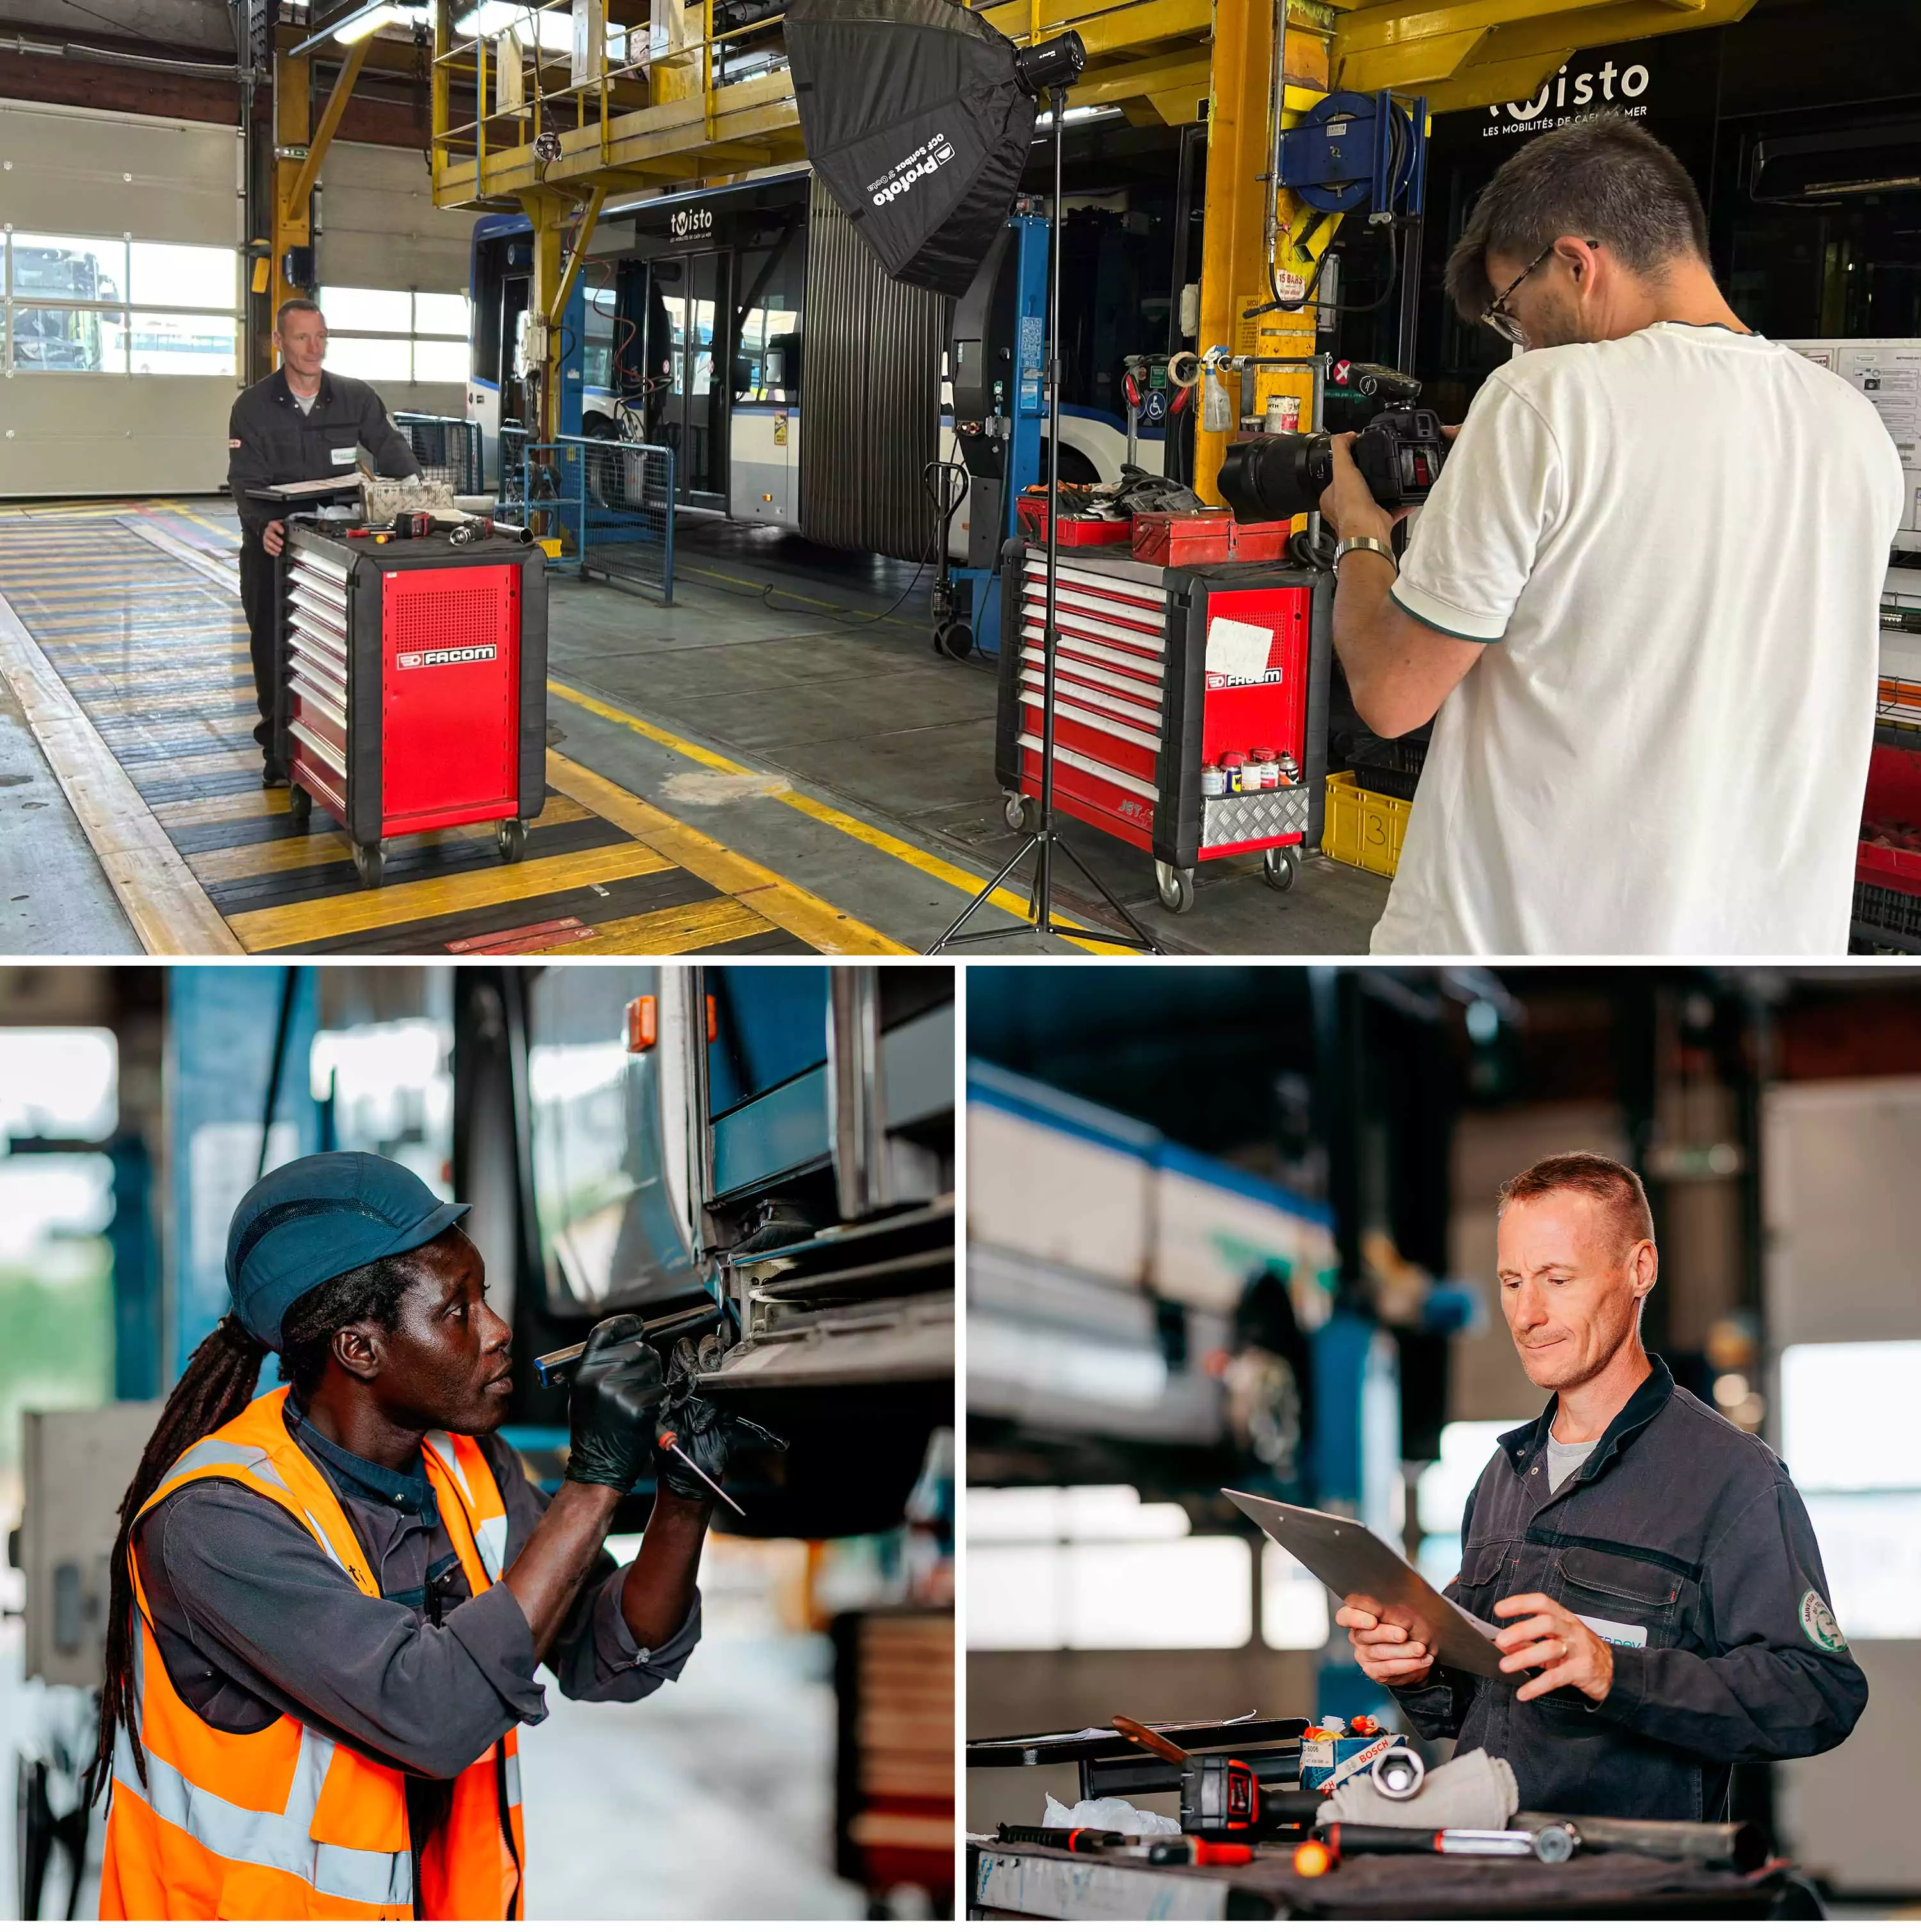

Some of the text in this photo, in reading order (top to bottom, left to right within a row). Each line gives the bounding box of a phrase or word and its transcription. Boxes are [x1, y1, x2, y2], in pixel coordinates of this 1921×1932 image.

[1483, 126, 1498, 136] LES
[1502, 118, 1553, 134] MOBILITÉS
[1625, 106, 1647, 118] MER
[927, 133, 944, 150] OCF
[895, 147, 927, 172] Softbox
[866, 175, 889, 192] Octa
[873, 155, 939, 206] Profoto
[670, 209, 712, 236] twisto
[1279, 274, 1302, 285] 15 BARS
[425, 647, 494, 665] FACOM
[1366, 815, 1386, 845] 3
[1359, 1739, 1389, 1764] BOSCH
